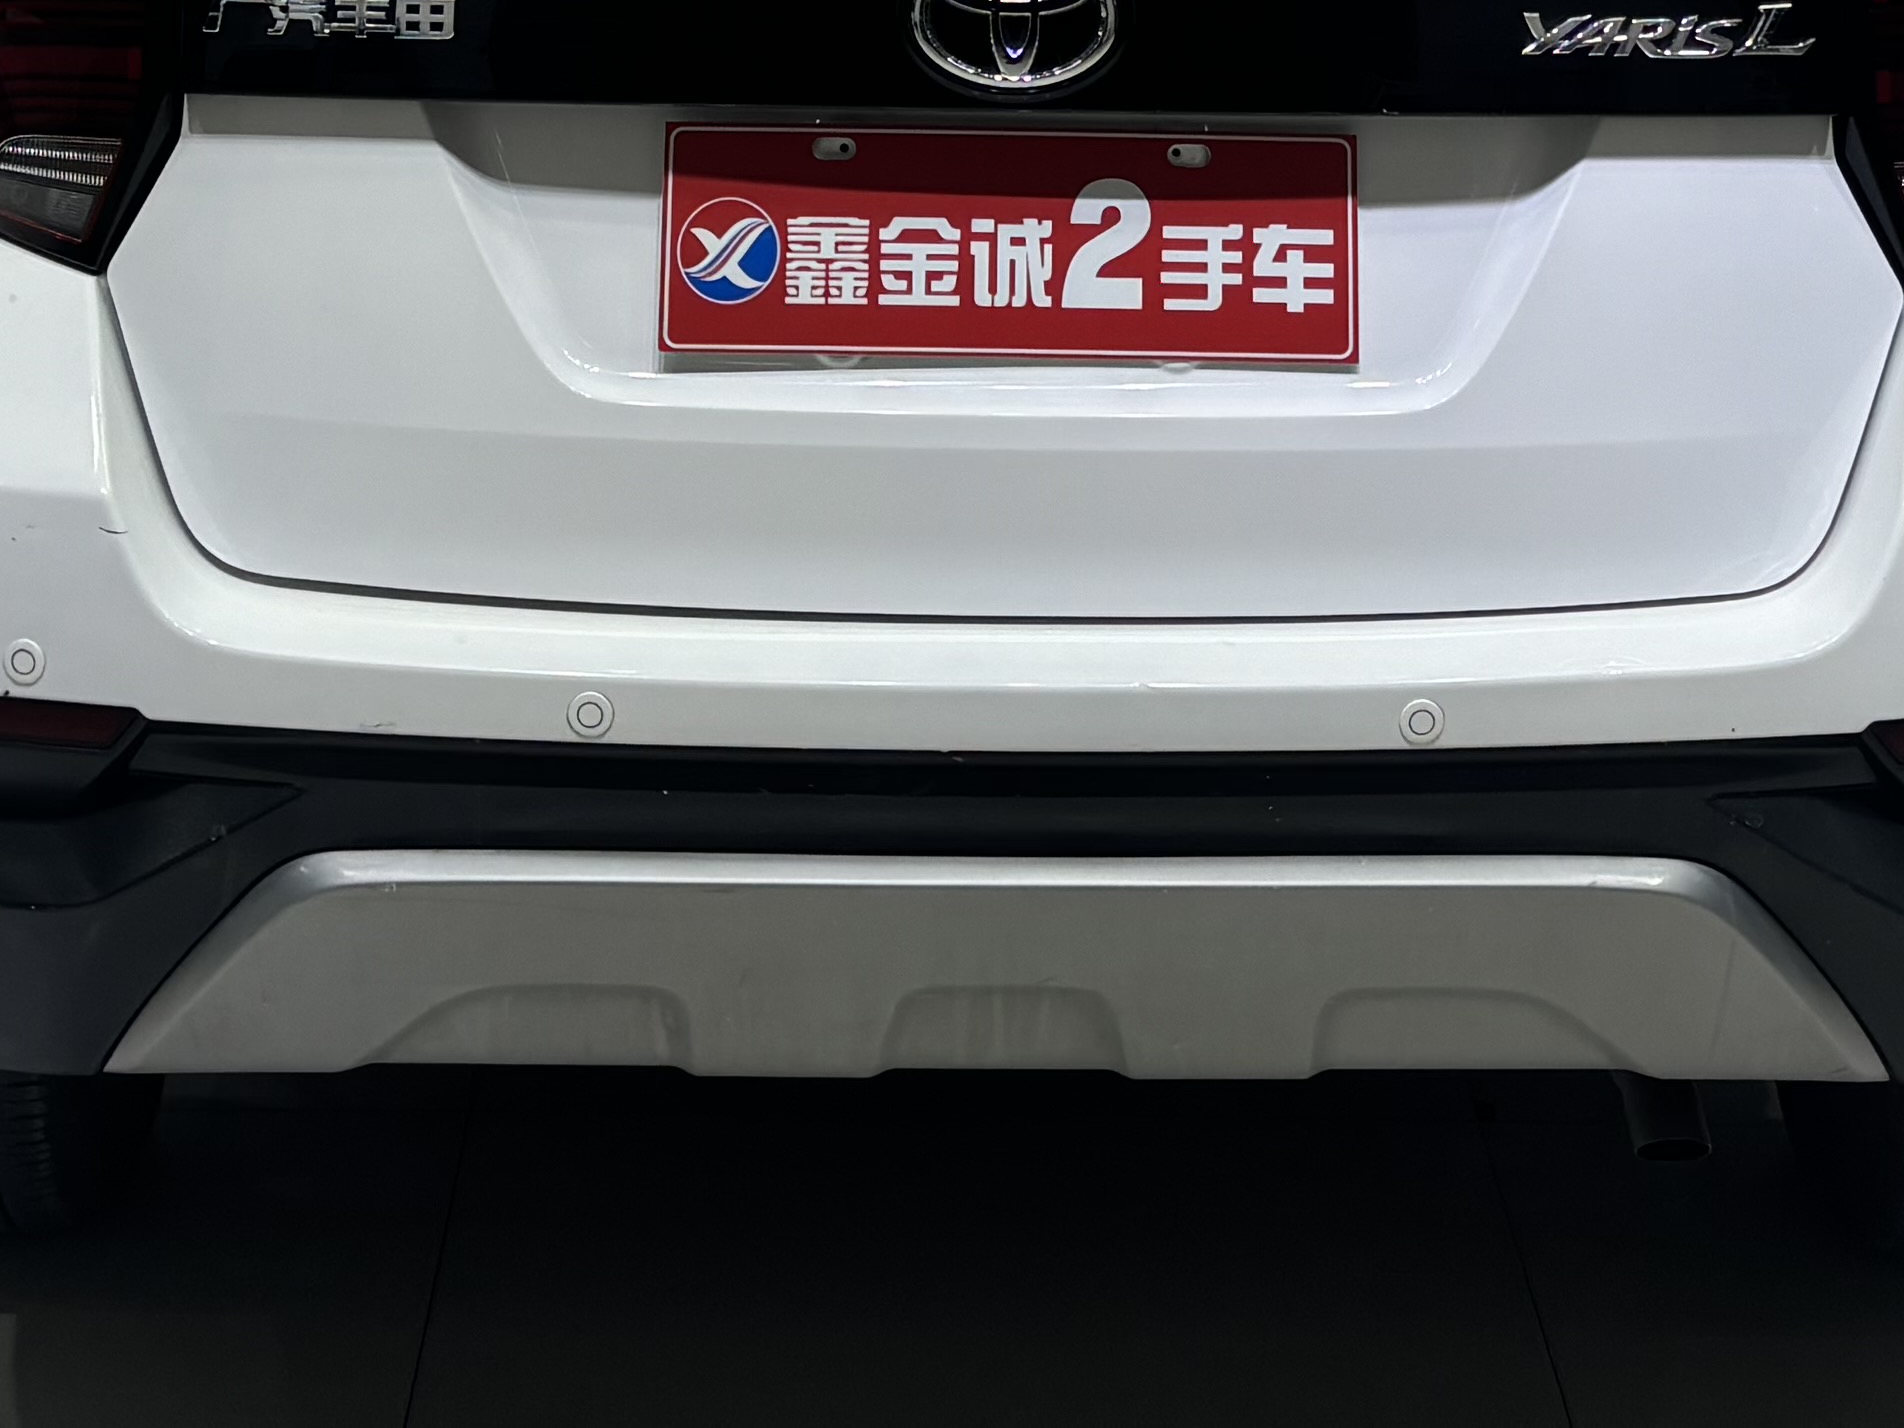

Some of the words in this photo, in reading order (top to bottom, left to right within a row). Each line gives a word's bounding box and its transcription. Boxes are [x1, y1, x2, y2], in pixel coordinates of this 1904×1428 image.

[1522, 12, 1743, 59] YARIS
[784, 177, 1335, 313] 鑫金诚2手车
